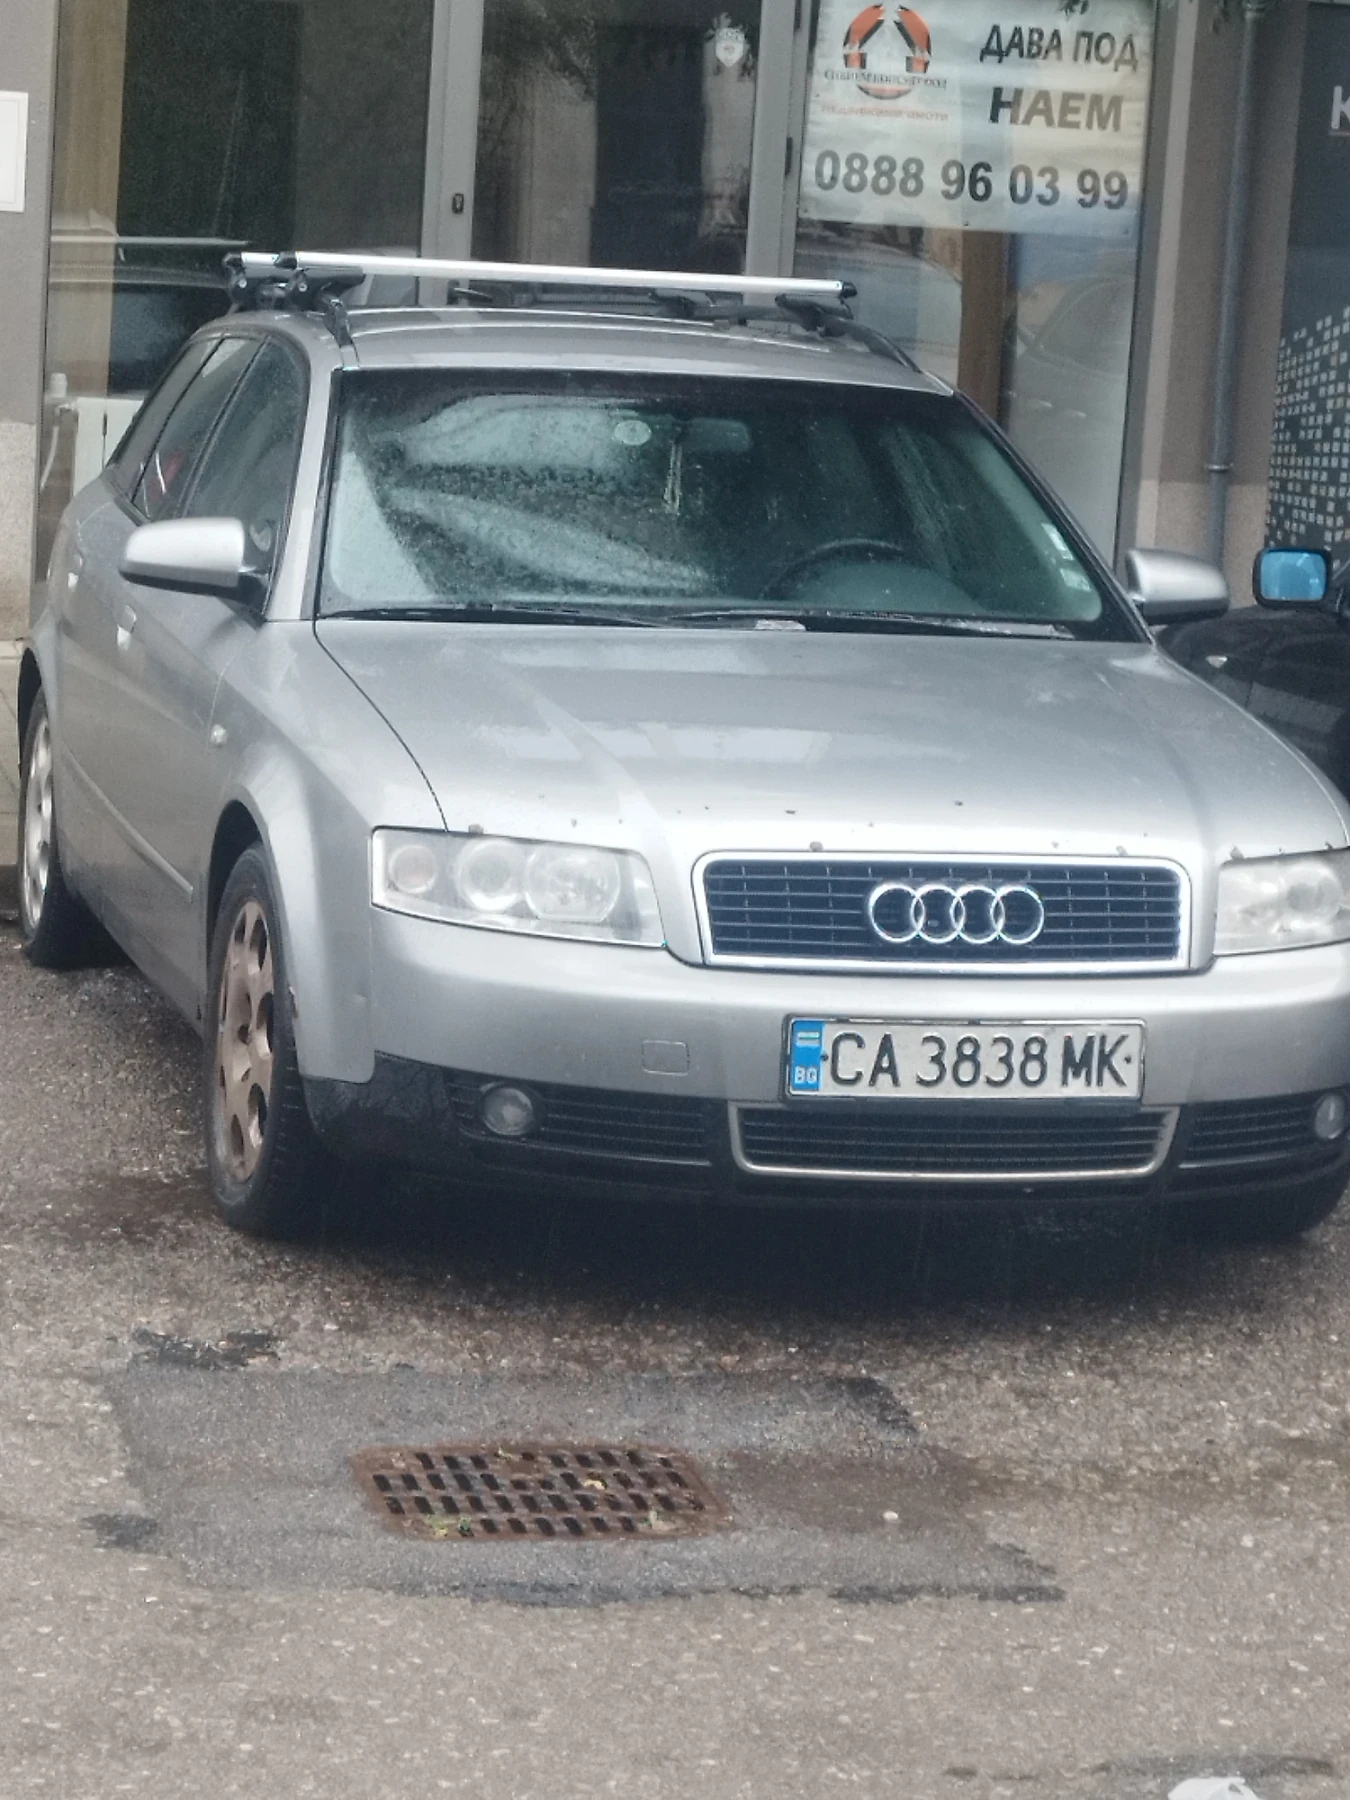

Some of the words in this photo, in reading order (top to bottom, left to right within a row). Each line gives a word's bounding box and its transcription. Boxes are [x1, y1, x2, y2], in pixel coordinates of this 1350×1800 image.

[980, 24, 1063, 63] ДАВА
[1073, 30, 1138, 72] ПОД
[990, 86, 1124, 132] НАЕМ
[814, 150, 925, 197] 0888
[941, 160, 993, 202] 96
[1009, 164, 1060, 206] 03
[1077, 168, 1129, 210] 99
[794, 1066, 818, 1085] BG
[829, 1031, 901, 1087] CA
[916, 1035, 1048, 1088] 3838
[1061, 1034, 1129, 1087] MK
